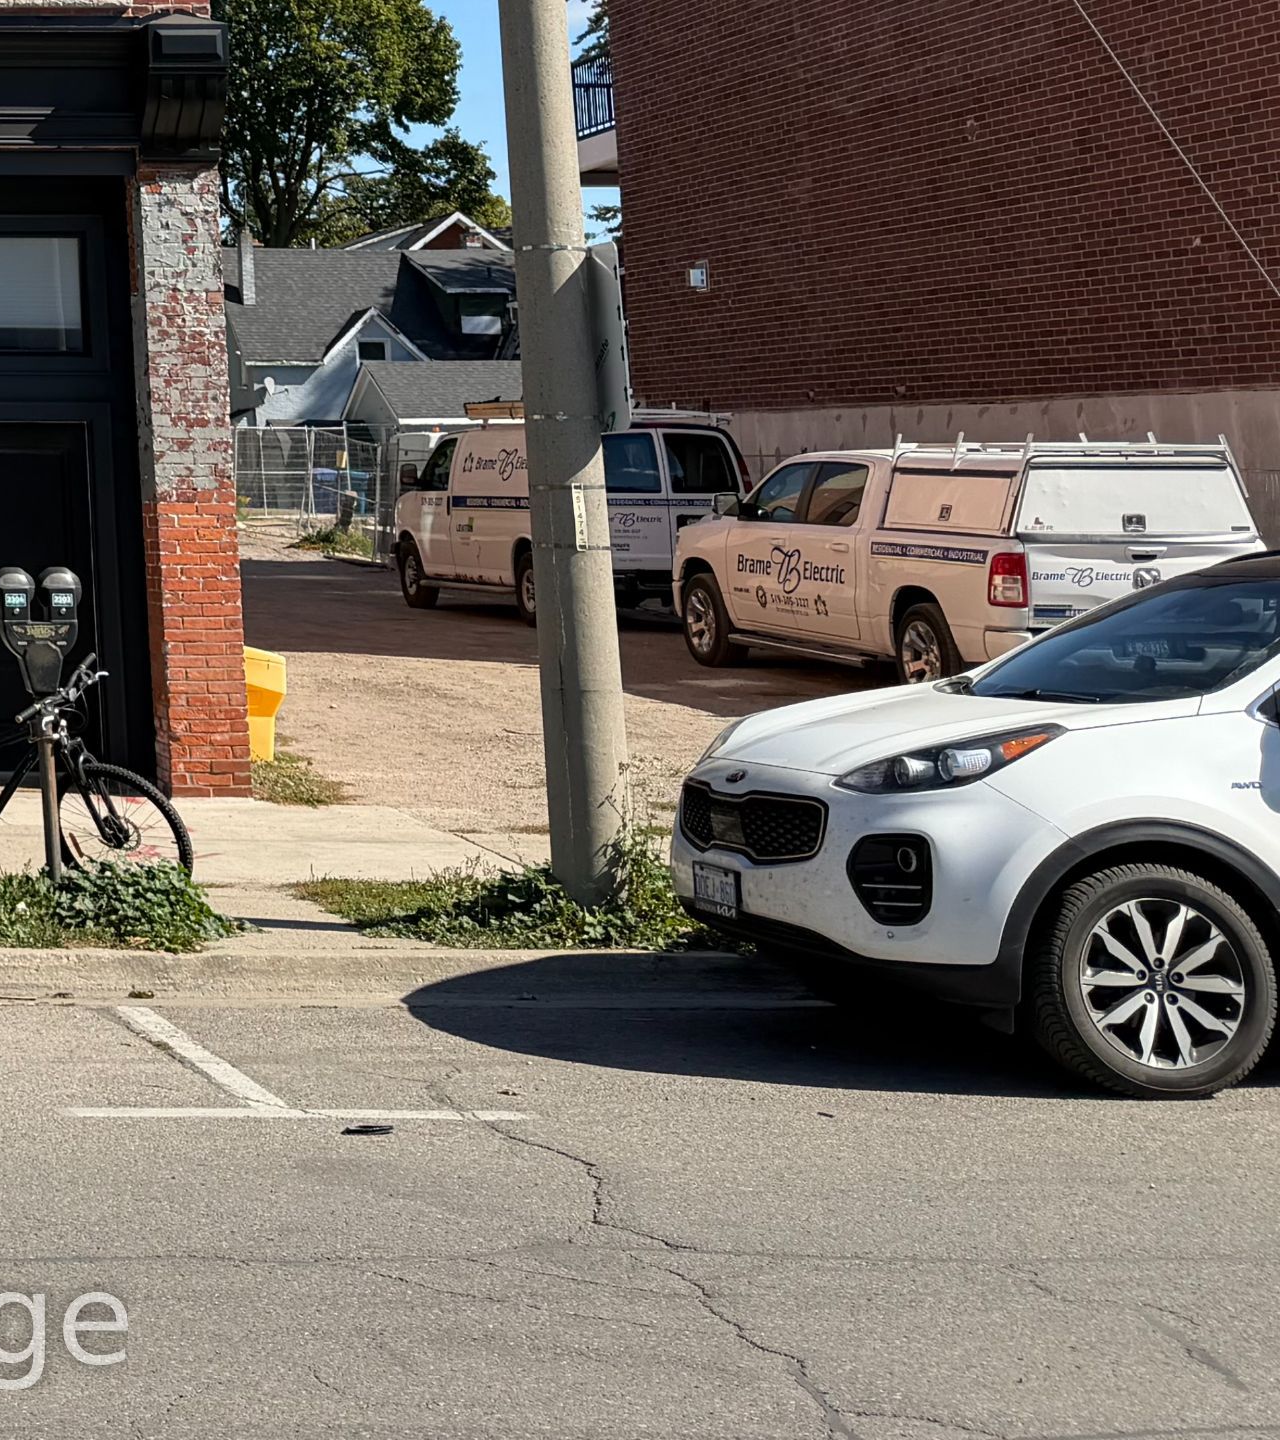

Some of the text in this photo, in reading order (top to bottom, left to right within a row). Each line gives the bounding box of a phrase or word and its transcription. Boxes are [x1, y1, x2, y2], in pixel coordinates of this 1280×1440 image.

[475, 456, 498, 470] Brame
[636, 515, 662, 524] Electric
[872, 544, 984, 562] RESIDENTIAL COMMERCIAL INDUSTRIAL
[737, 553, 772, 576] Brame
[803, 561, 846, 584] Electric
[1031, 570, 1066, 582] Brame
[1095, 570, 1132, 582] Electric
